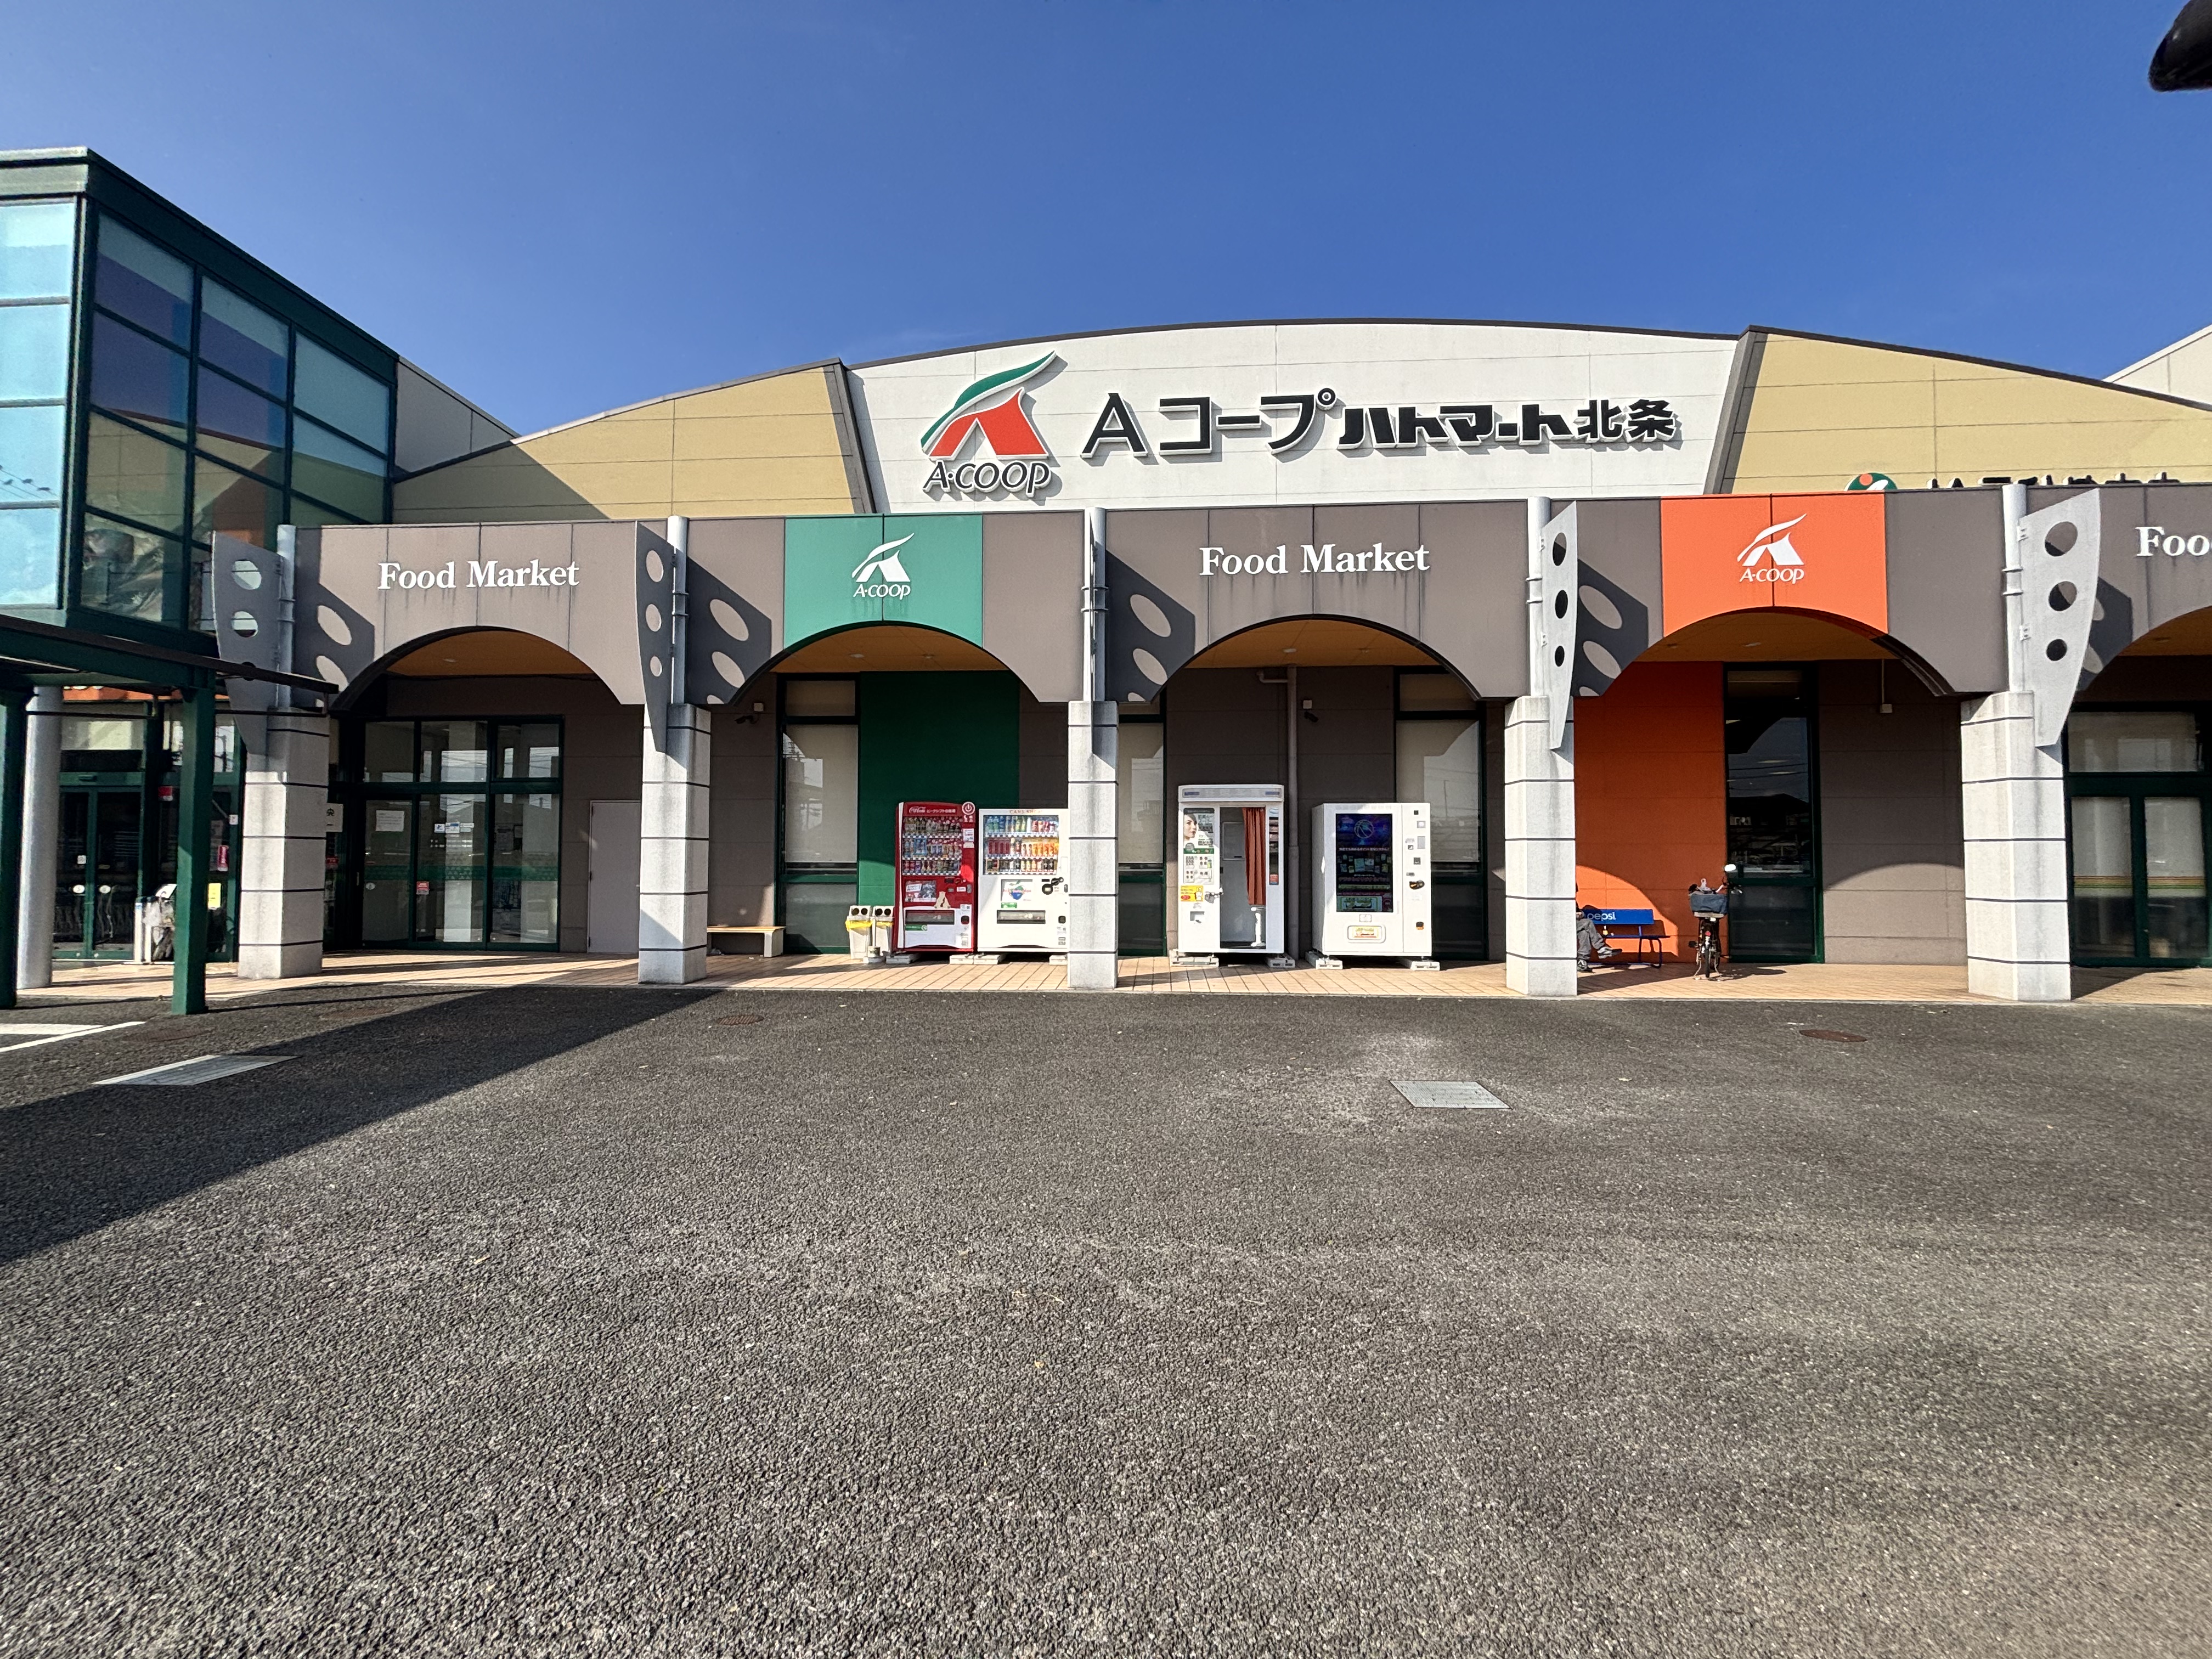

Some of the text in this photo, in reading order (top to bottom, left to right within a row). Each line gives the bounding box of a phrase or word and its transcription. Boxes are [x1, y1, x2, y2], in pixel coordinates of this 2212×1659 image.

[2135, 527, 2212, 556] Foo
[1199, 543, 1430, 575] Food Market
[377, 559, 579, 589] Food Market
[1587, 912, 1616, 921] pepsi
